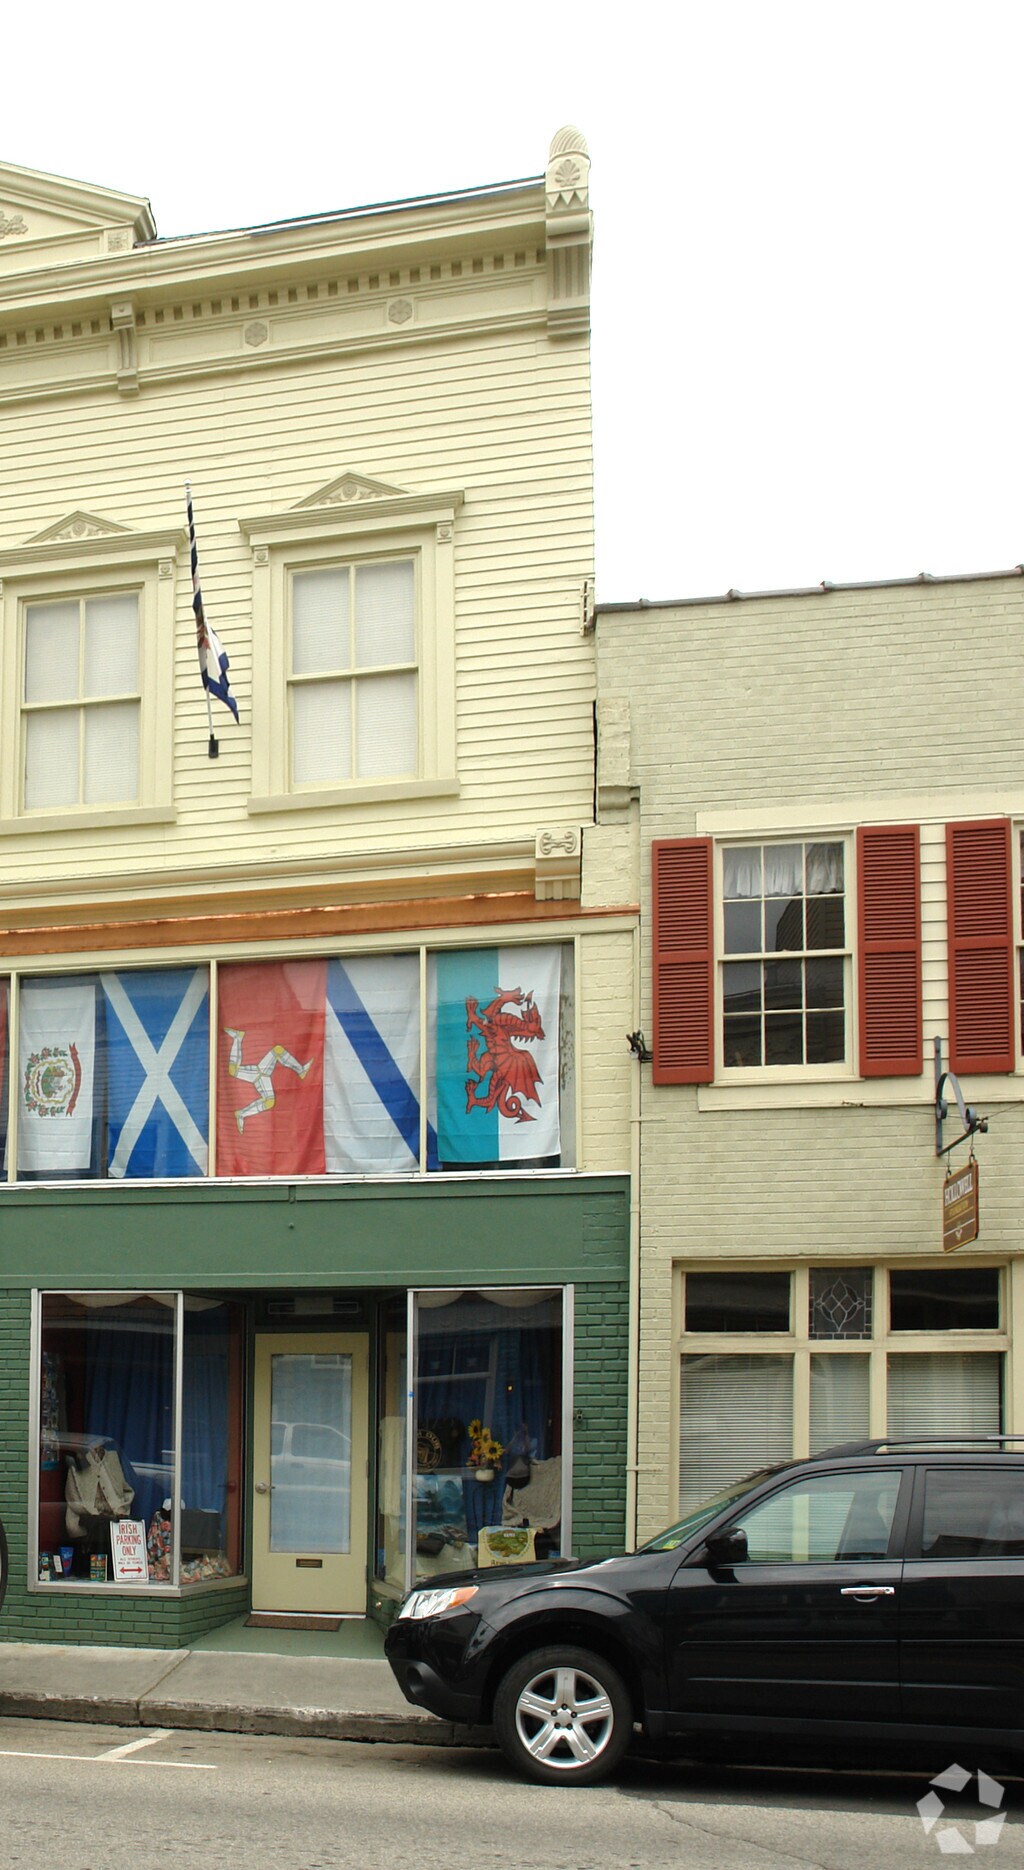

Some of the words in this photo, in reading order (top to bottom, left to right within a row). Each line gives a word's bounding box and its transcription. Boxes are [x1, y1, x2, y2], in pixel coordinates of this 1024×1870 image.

[119, 1523, 138, 1534] IRISH
[116, 1534, 141, 1545] PARKING
[121, 1545, 136, 1556] ONLY
